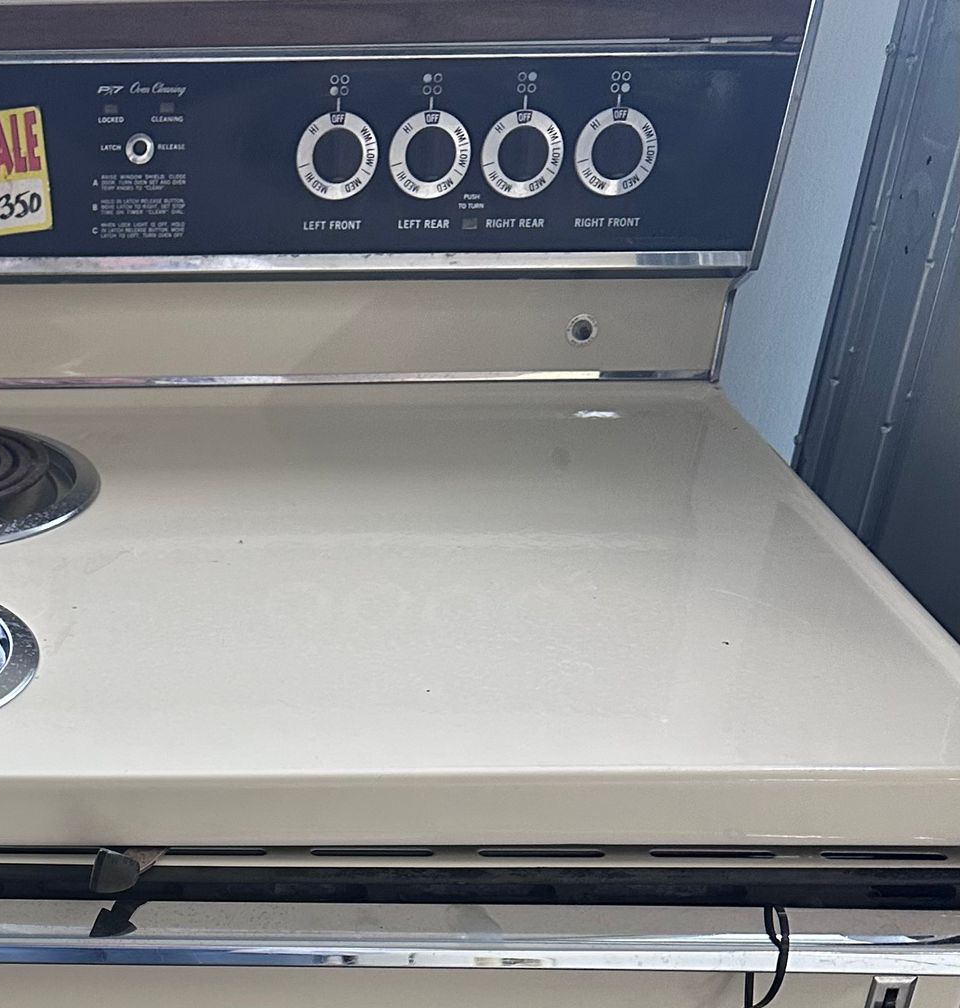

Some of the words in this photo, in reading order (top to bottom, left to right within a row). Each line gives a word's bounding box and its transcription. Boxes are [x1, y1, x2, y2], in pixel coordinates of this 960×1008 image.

[98, 116, 124, 124] LOCKED
[332, 114, 344, 123] OFF
[426, 114, 439, 122] OFF
[518, 113, 531, 122] OFF
[614, 110, 627, 120] OFF
[309, 124, 319, 135] HI
[403, 123, 413, 134] HI
[495, 122, 506, 134] HI
[590, 119, 600, 130] HI
[642, 122, 654, 139] WM
[360, 126, 372, 142] WM
[454, 126, 466, 142] WM
[546, 124, 558, 141] WM
[366, 149, 374, 167] LOW
[458, 149, 468, 168] LOW
[552, 148, 560, 166] LOW
[644, 146, 656, 164] LOW
[304, 172, 314, 182] HI
[396, 171, 406, 182] HI
[488, 170, 498, 181] HI
[582, 168, 592, 178] HI
[312, 180, 329, 194] MED
[344, 178, 362, 192] MED
[403, 179, 419, 193] MED
[436, 178, 454, 192] MED
[496, 179, 512, 192] MED
[529, 178, 546, 192] MED
[590, 176, 606, 190] MED
[622, 175, 640, 189] MED
[304, 221, 328, 230] LEFT
[330, 220, 362, 230] FRONT
[398, 220, 422, 228] LEFT
[424, 219, 450, 228] REAR
[486, 219, 516, 228] RIGHT
[519, 218, 544, 228] REAR
[574, 218, 604, 227] RIGHT
[608, 217, 640, 226] FRONT
